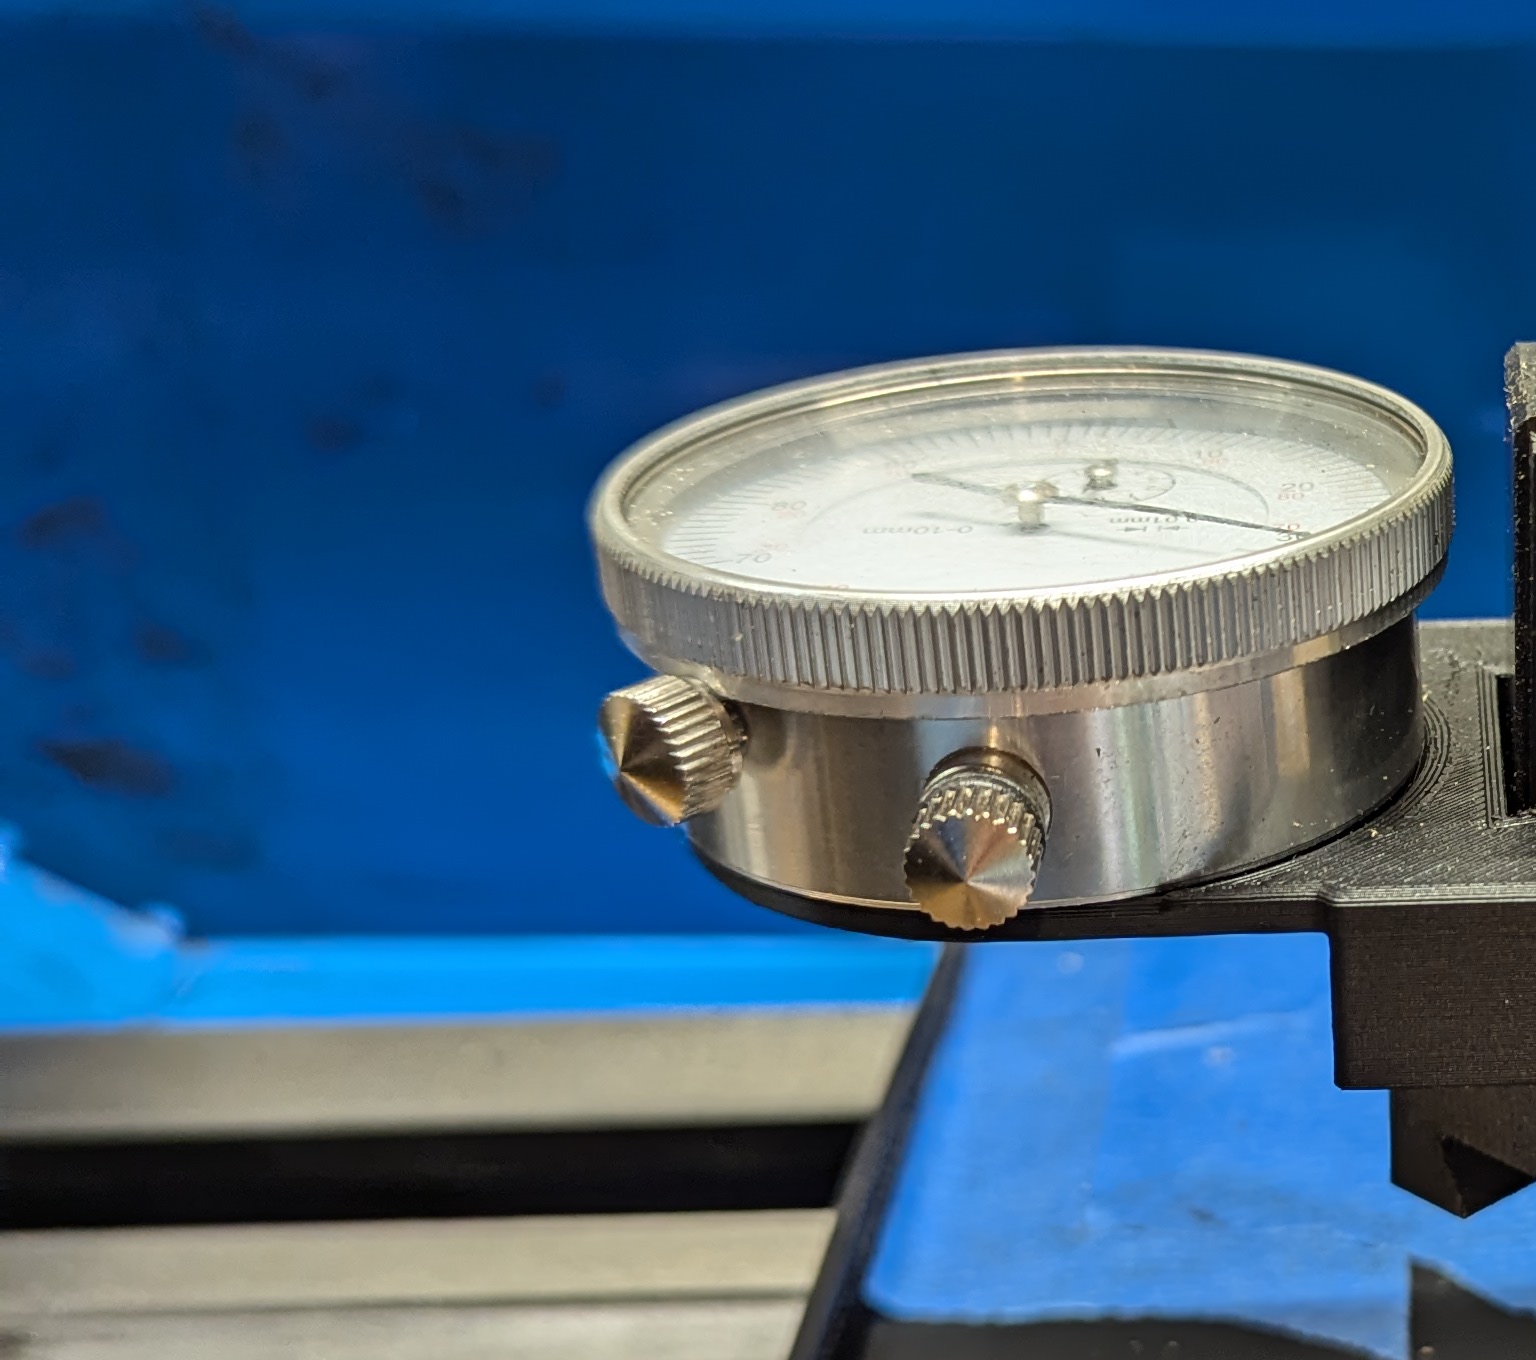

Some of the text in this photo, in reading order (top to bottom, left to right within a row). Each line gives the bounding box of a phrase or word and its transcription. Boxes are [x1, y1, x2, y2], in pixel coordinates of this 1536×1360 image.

[1281, 482, 1314, 493] 20
[770, 499, 807, 512] 80
[862, 525, 973, 535] 0-10mm
[735, 552, 772, 564] 70
